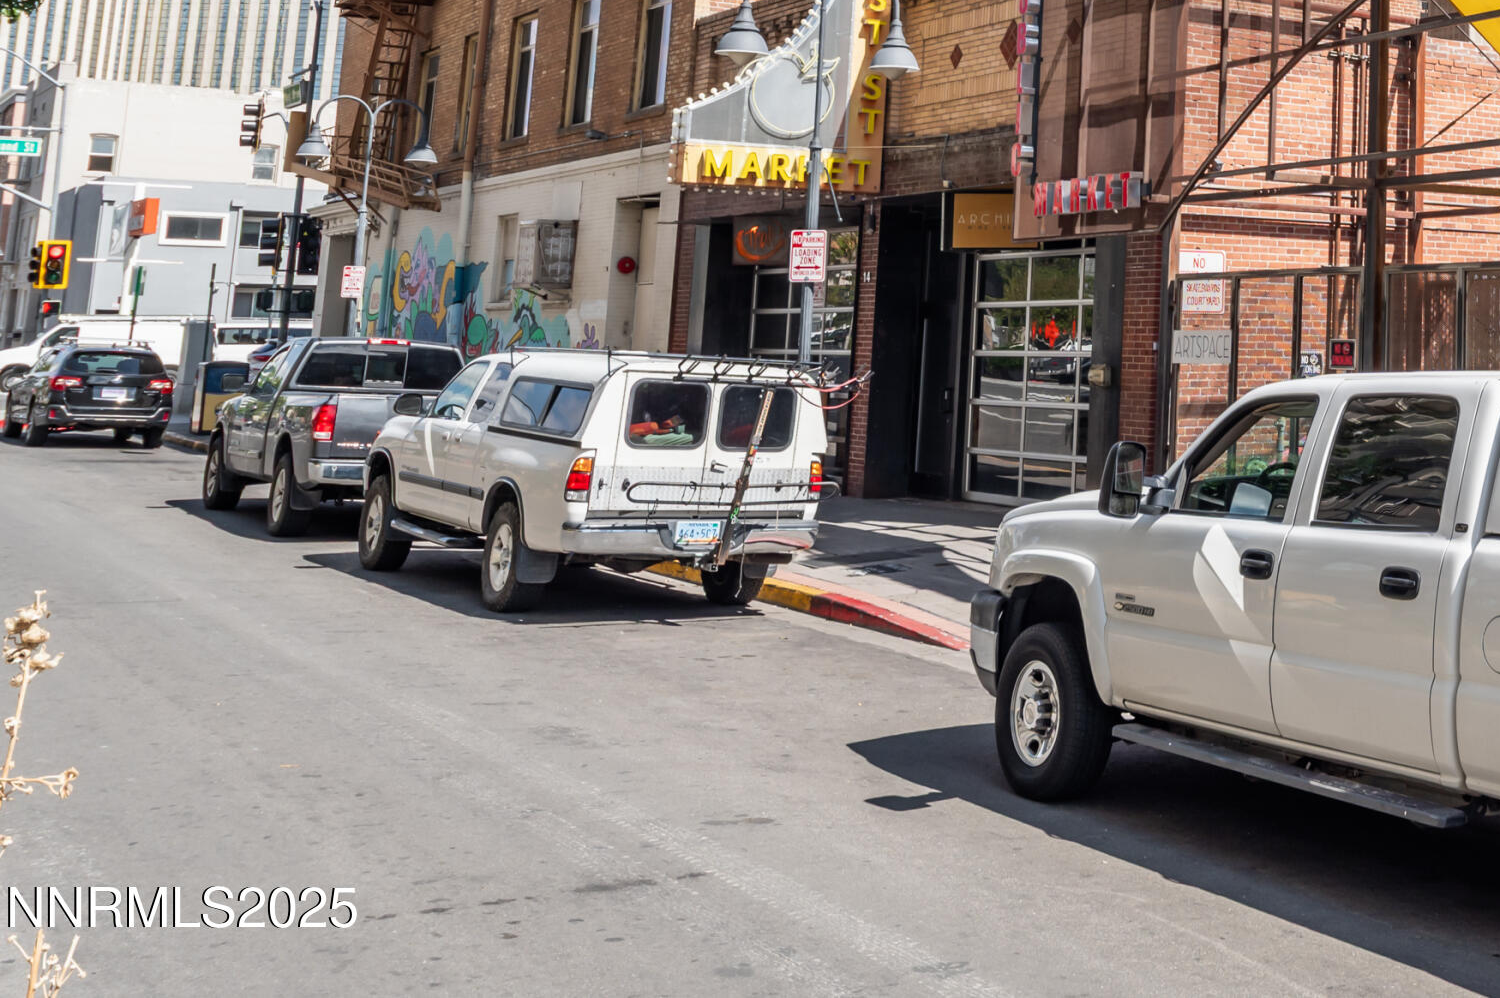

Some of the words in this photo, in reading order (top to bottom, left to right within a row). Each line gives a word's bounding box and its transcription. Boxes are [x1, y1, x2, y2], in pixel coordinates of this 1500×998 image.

[860, 73, 883, 135] ST
[1034, 171, 1137, 216] MARKET
[794, 248, 822, 257] LOADING
[800, 257, 816, 265] ZONE
[1192, 257, 1206, 269] NO
[863, 271, 871, 283] 14
[1174, 334, 1230, 359] ARTSPACE
